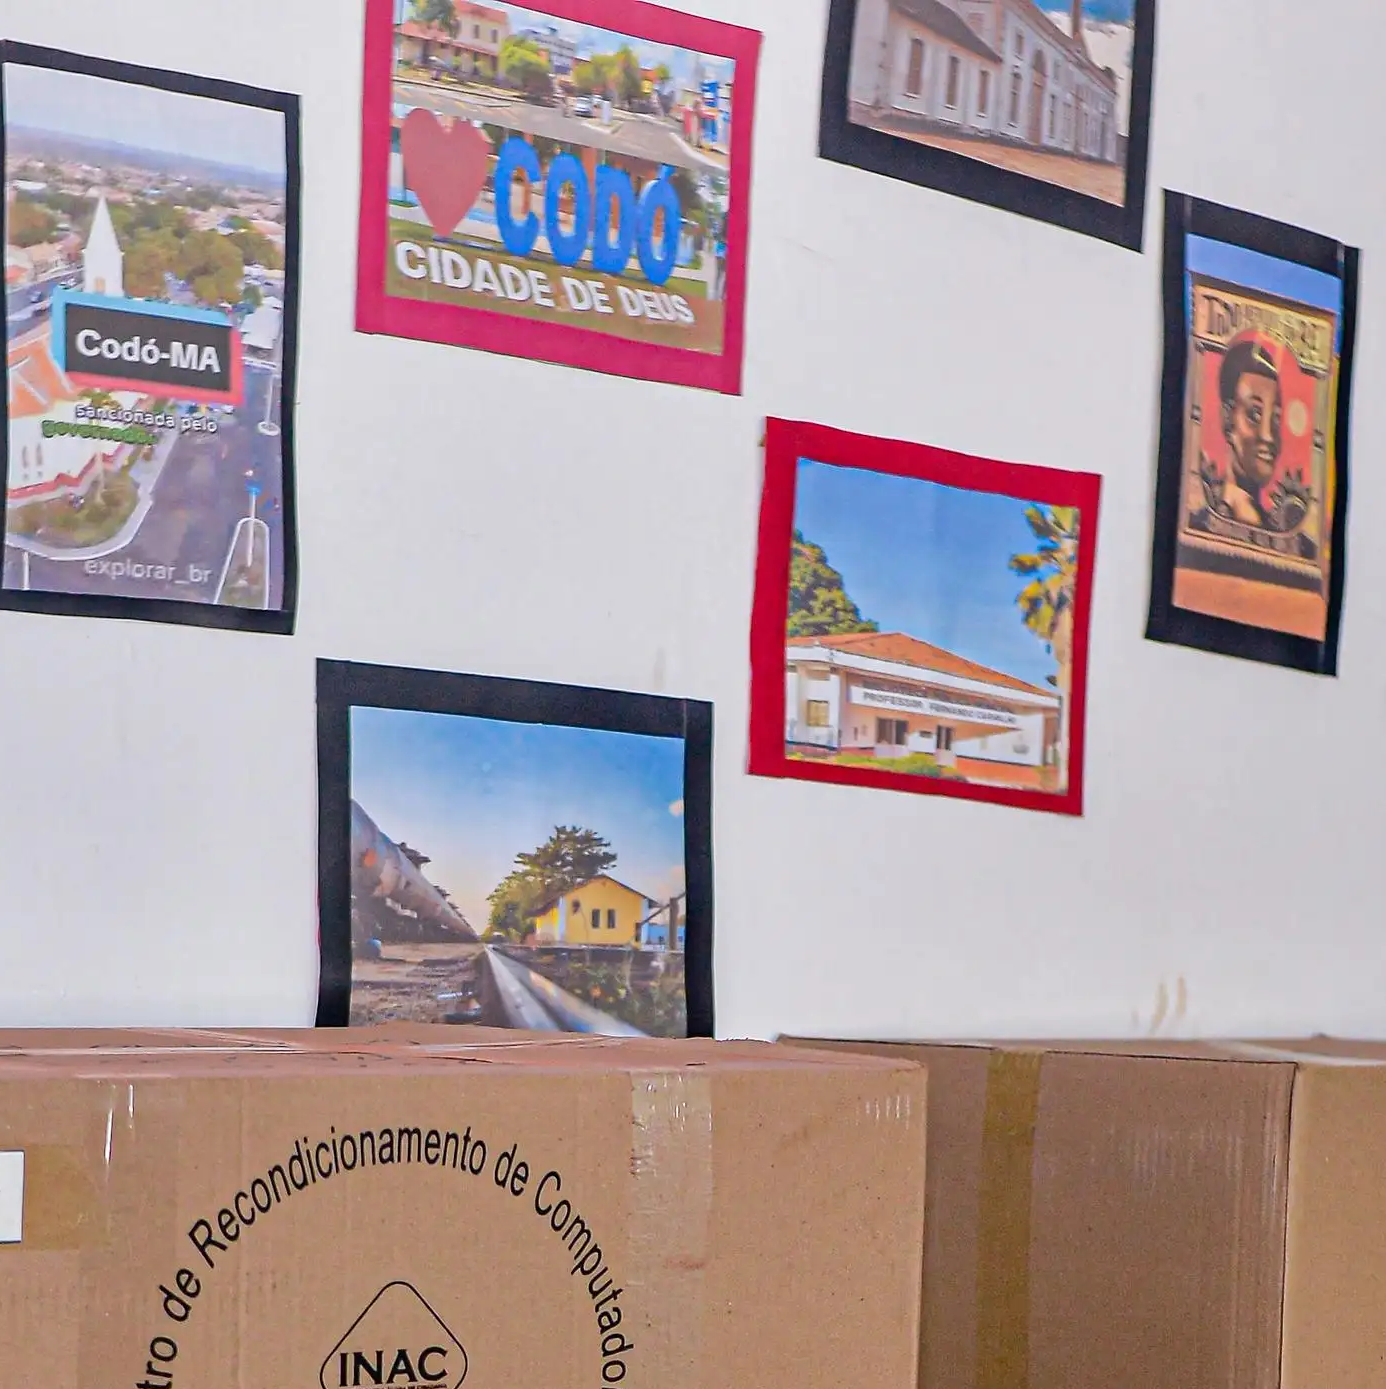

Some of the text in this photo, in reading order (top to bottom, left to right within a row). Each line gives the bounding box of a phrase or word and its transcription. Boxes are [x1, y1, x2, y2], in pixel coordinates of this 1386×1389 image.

[495, 135, 681, 286] CODÓ
[395, 241, 695, 324] CIDADE DE DEUS
[76, 329, 221, 373] Codó-MA
[76, 404, 218, 433] sancionada pelo
[84, 557, 212, 585] explorar_br
[159, 1267, 201, 1323] de
[188, 1125, 486, 1268] Recondicionamento
[495, 1144, 529, 1196] de
[340, 1346, 448, 1387] INAC
